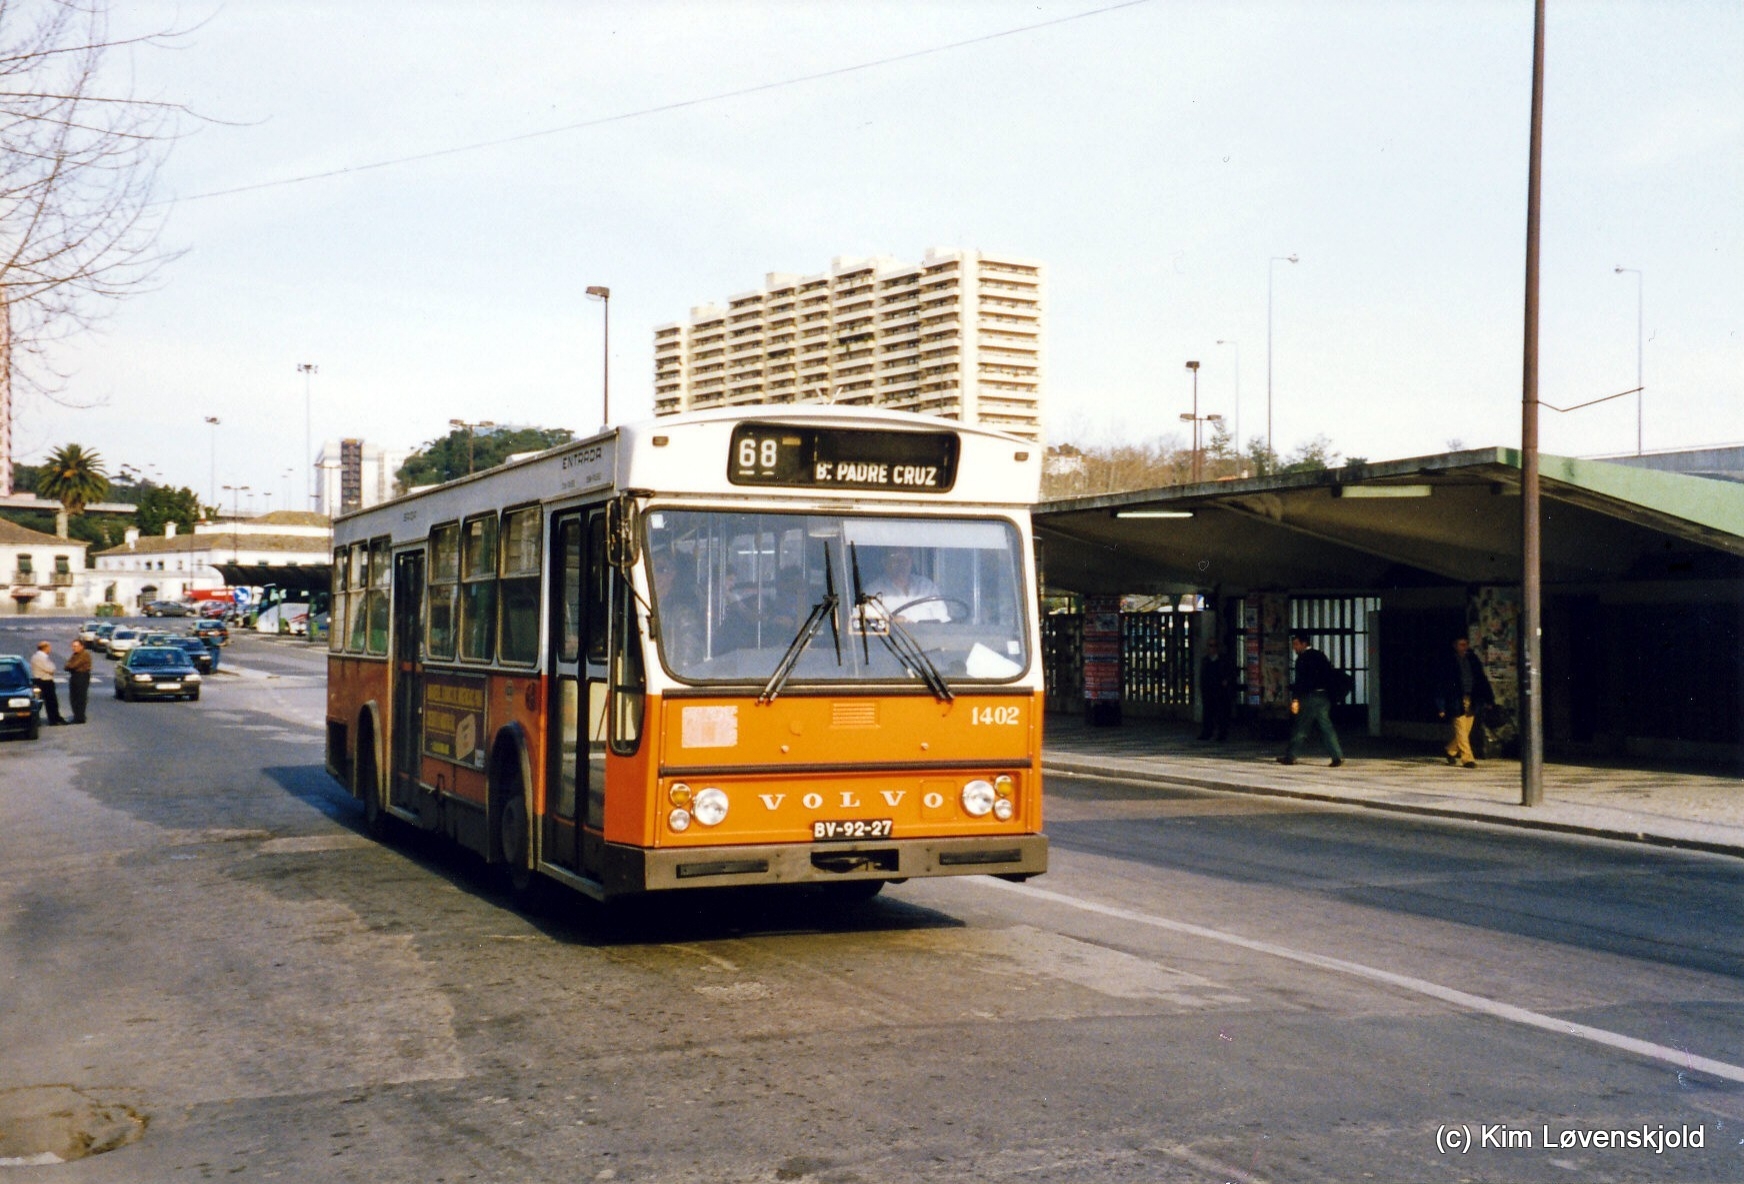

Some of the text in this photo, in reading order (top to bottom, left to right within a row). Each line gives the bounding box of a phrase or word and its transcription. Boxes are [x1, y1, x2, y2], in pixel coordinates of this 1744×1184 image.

[562, 447, 602, 470] ENTRADA
[738, 438, 777, 467] 68
[836, 462, 888, 483] PADRE
[893, 465, 938, 487] CRUZ
[971, 706, 1019, 727] 1402
[758, 790, 944, 811] VOLVO
[814, 820, 893, 838] BV-92-27
